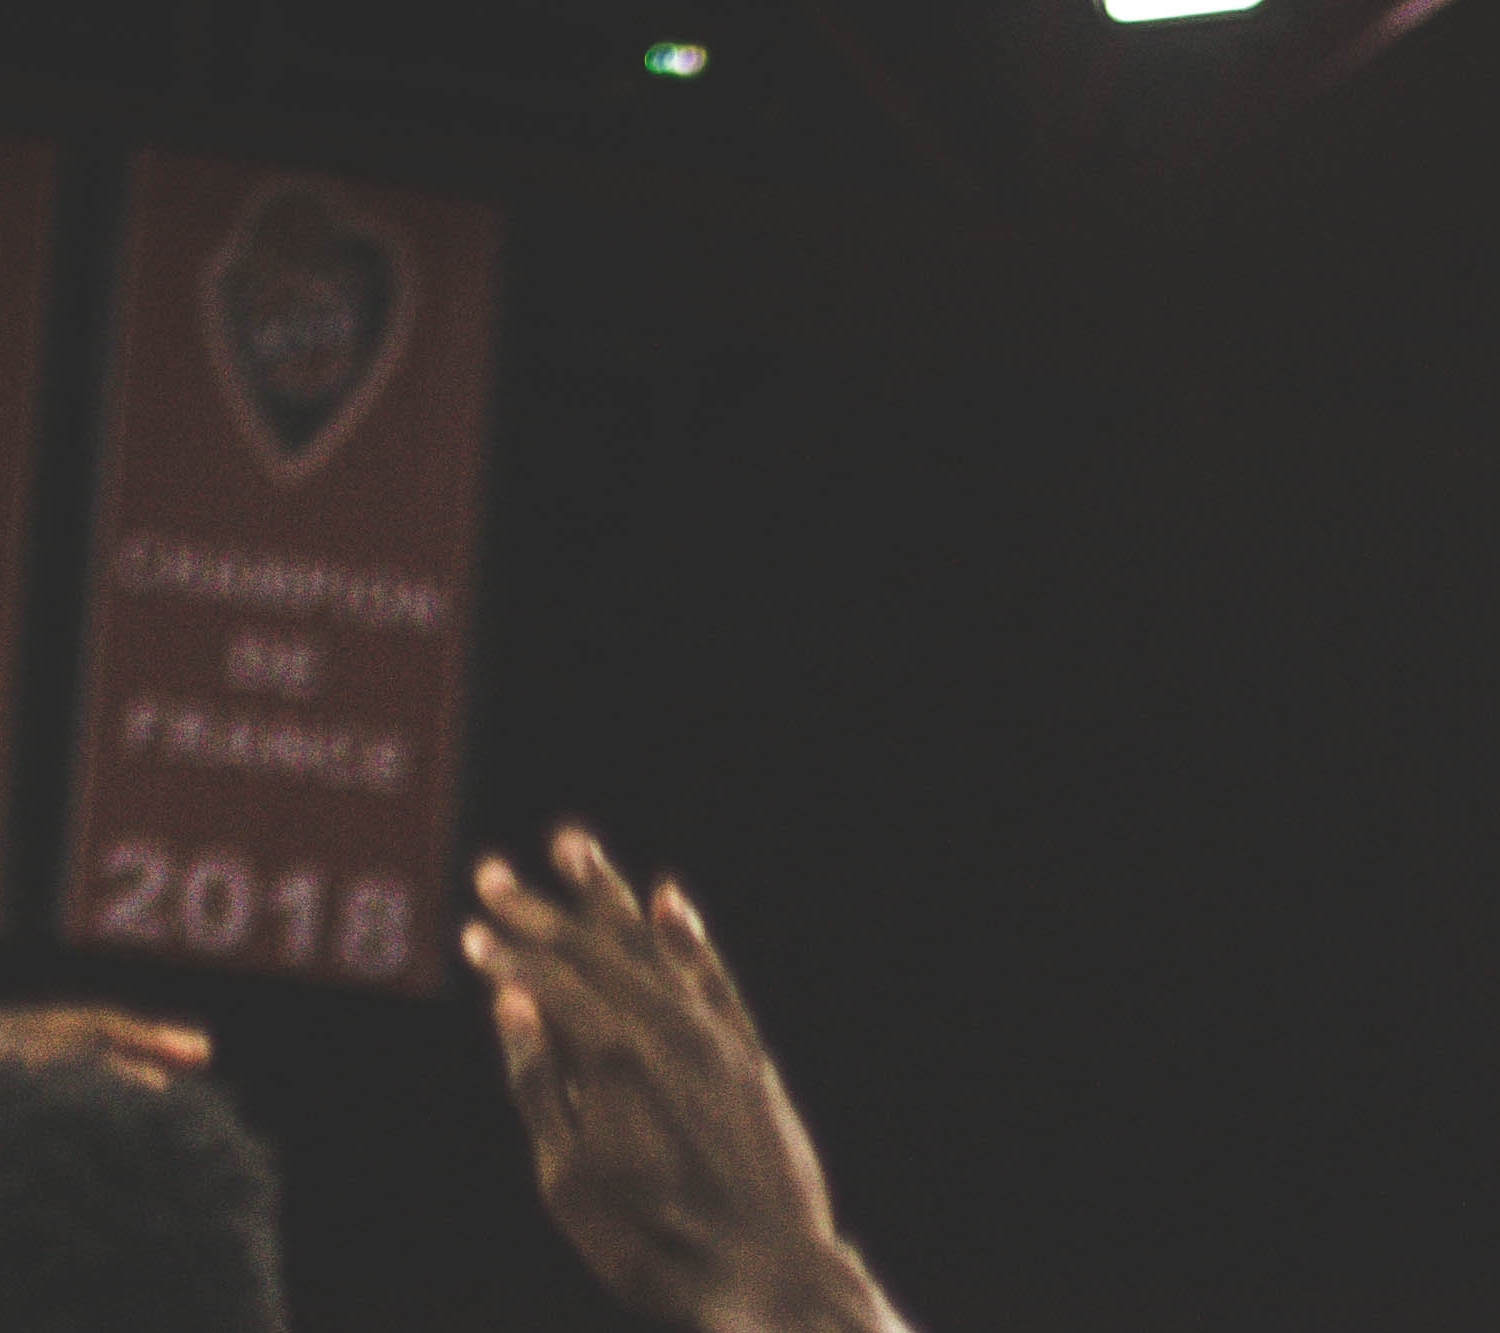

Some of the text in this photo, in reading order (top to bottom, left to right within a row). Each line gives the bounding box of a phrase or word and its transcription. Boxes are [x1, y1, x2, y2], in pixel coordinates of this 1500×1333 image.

[114, 530, 447, 631] CHAMPION
[226, 630, 322, 700] DE
[122, 695, 409, 795] FRANCE
[97, 834, 416, 977] 2018
